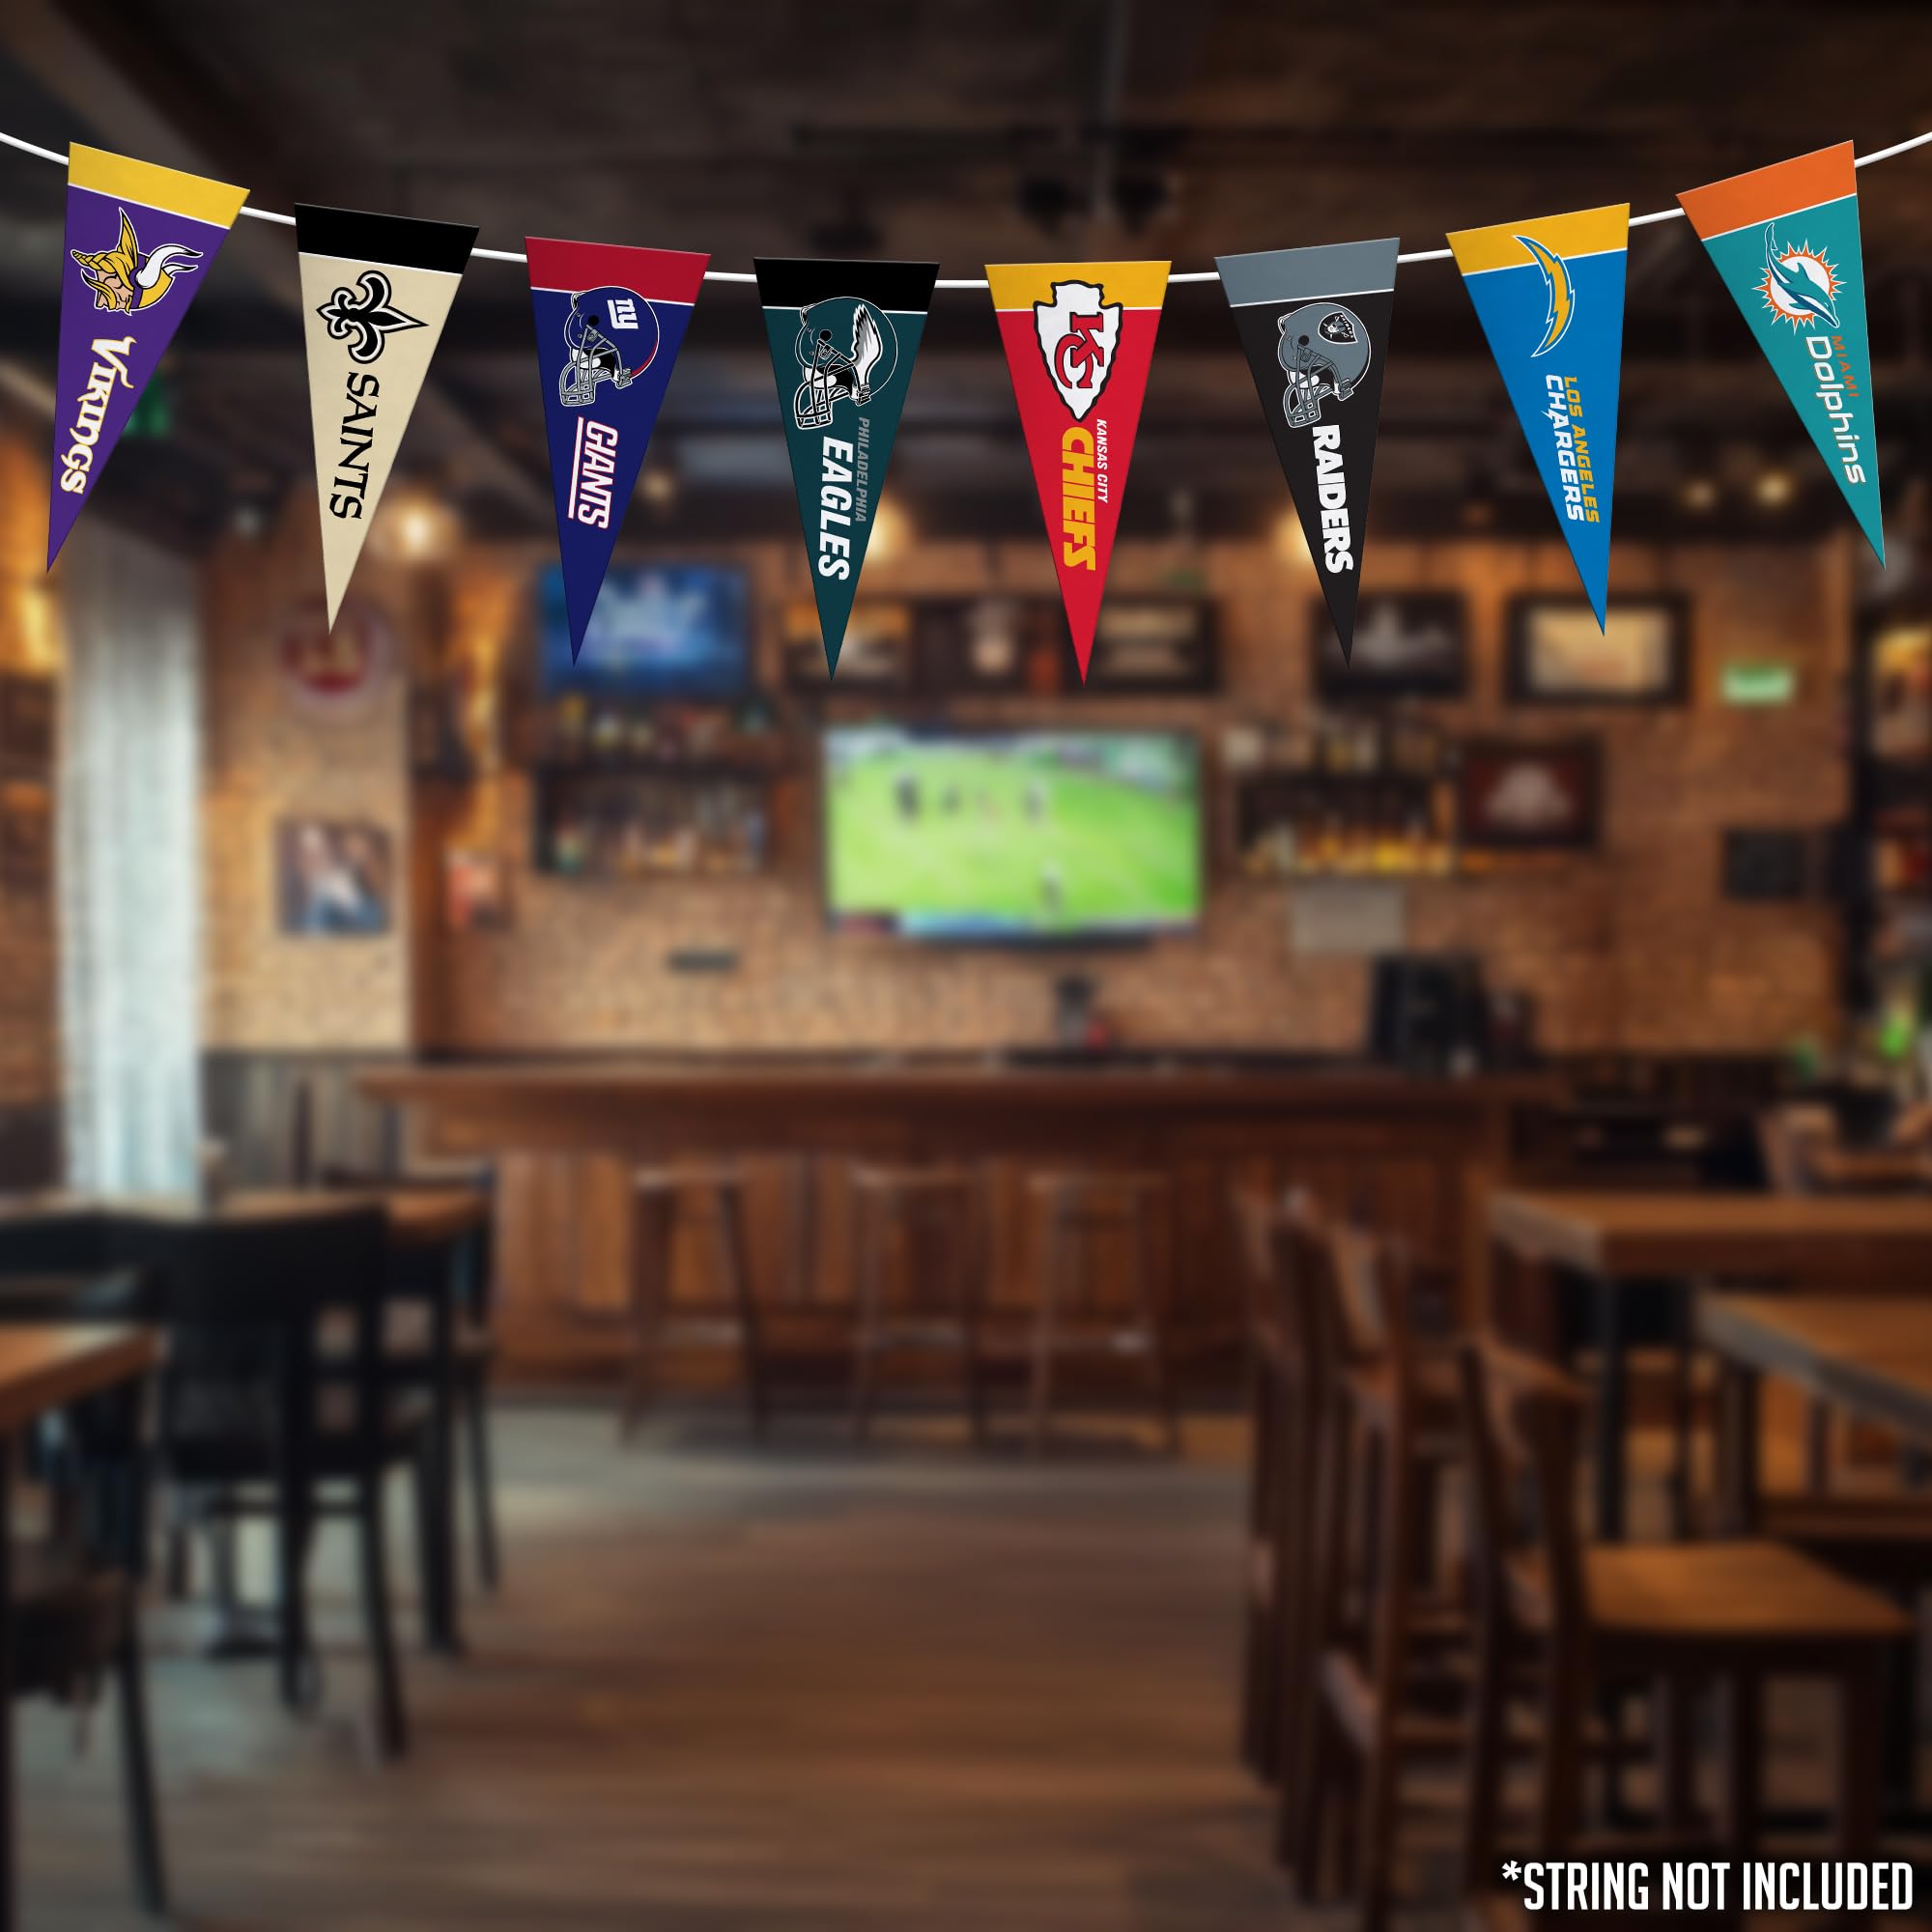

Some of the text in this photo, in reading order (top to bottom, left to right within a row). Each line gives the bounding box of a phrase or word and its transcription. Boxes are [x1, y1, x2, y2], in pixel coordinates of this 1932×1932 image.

[1054, 311, 1104, 389] KC
[1805, 336, 1866, 485] Dolphins
[1831, 335, 1860, 398] MIAMI
[329, 371, 380, 520] SAINTS
[577, 419, 619, 529] GIANTS
[817, 436, 854, 581] EAGLES
[854, 416, 870, 523] PHILADELPHIA
[1062, 426, 1096, 571] CHIEFS
[1096, 418, 1108, 503] KANSAS CITY
[1312, 424, 1354, 574] RAIDERS
[1542, 374, 1585, 523] CHARGERS
[1563, 376, 1601, 524] LOS ANGELES
